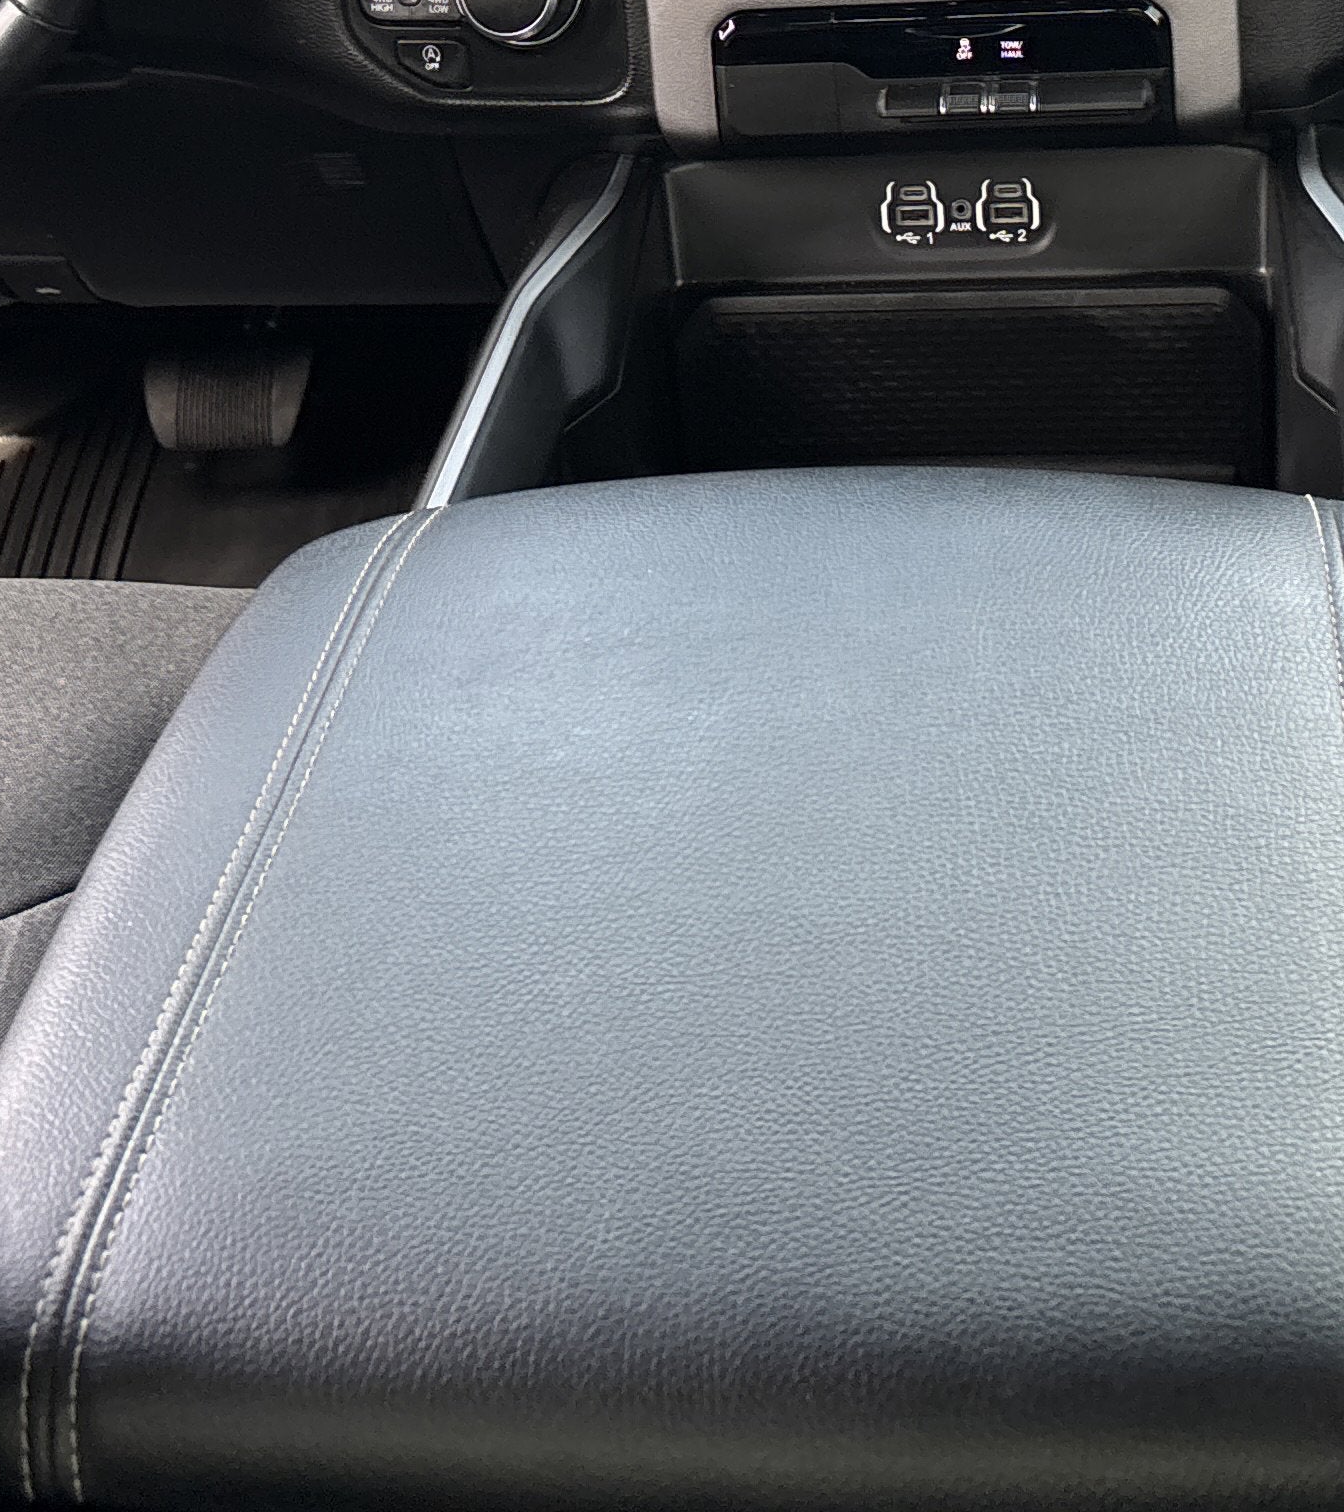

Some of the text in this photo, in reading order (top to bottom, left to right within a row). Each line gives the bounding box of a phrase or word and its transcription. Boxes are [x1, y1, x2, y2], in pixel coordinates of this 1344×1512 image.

[371, 3, 393, 12] HIGH
[429, 4, 449, 14] LOW
[1001, 50, 1024, 58] HAUL
[950, 222, 972, 231] AUX
[926, 232, 934, 245] 1
[1017, 229, 1027, 242] 2
